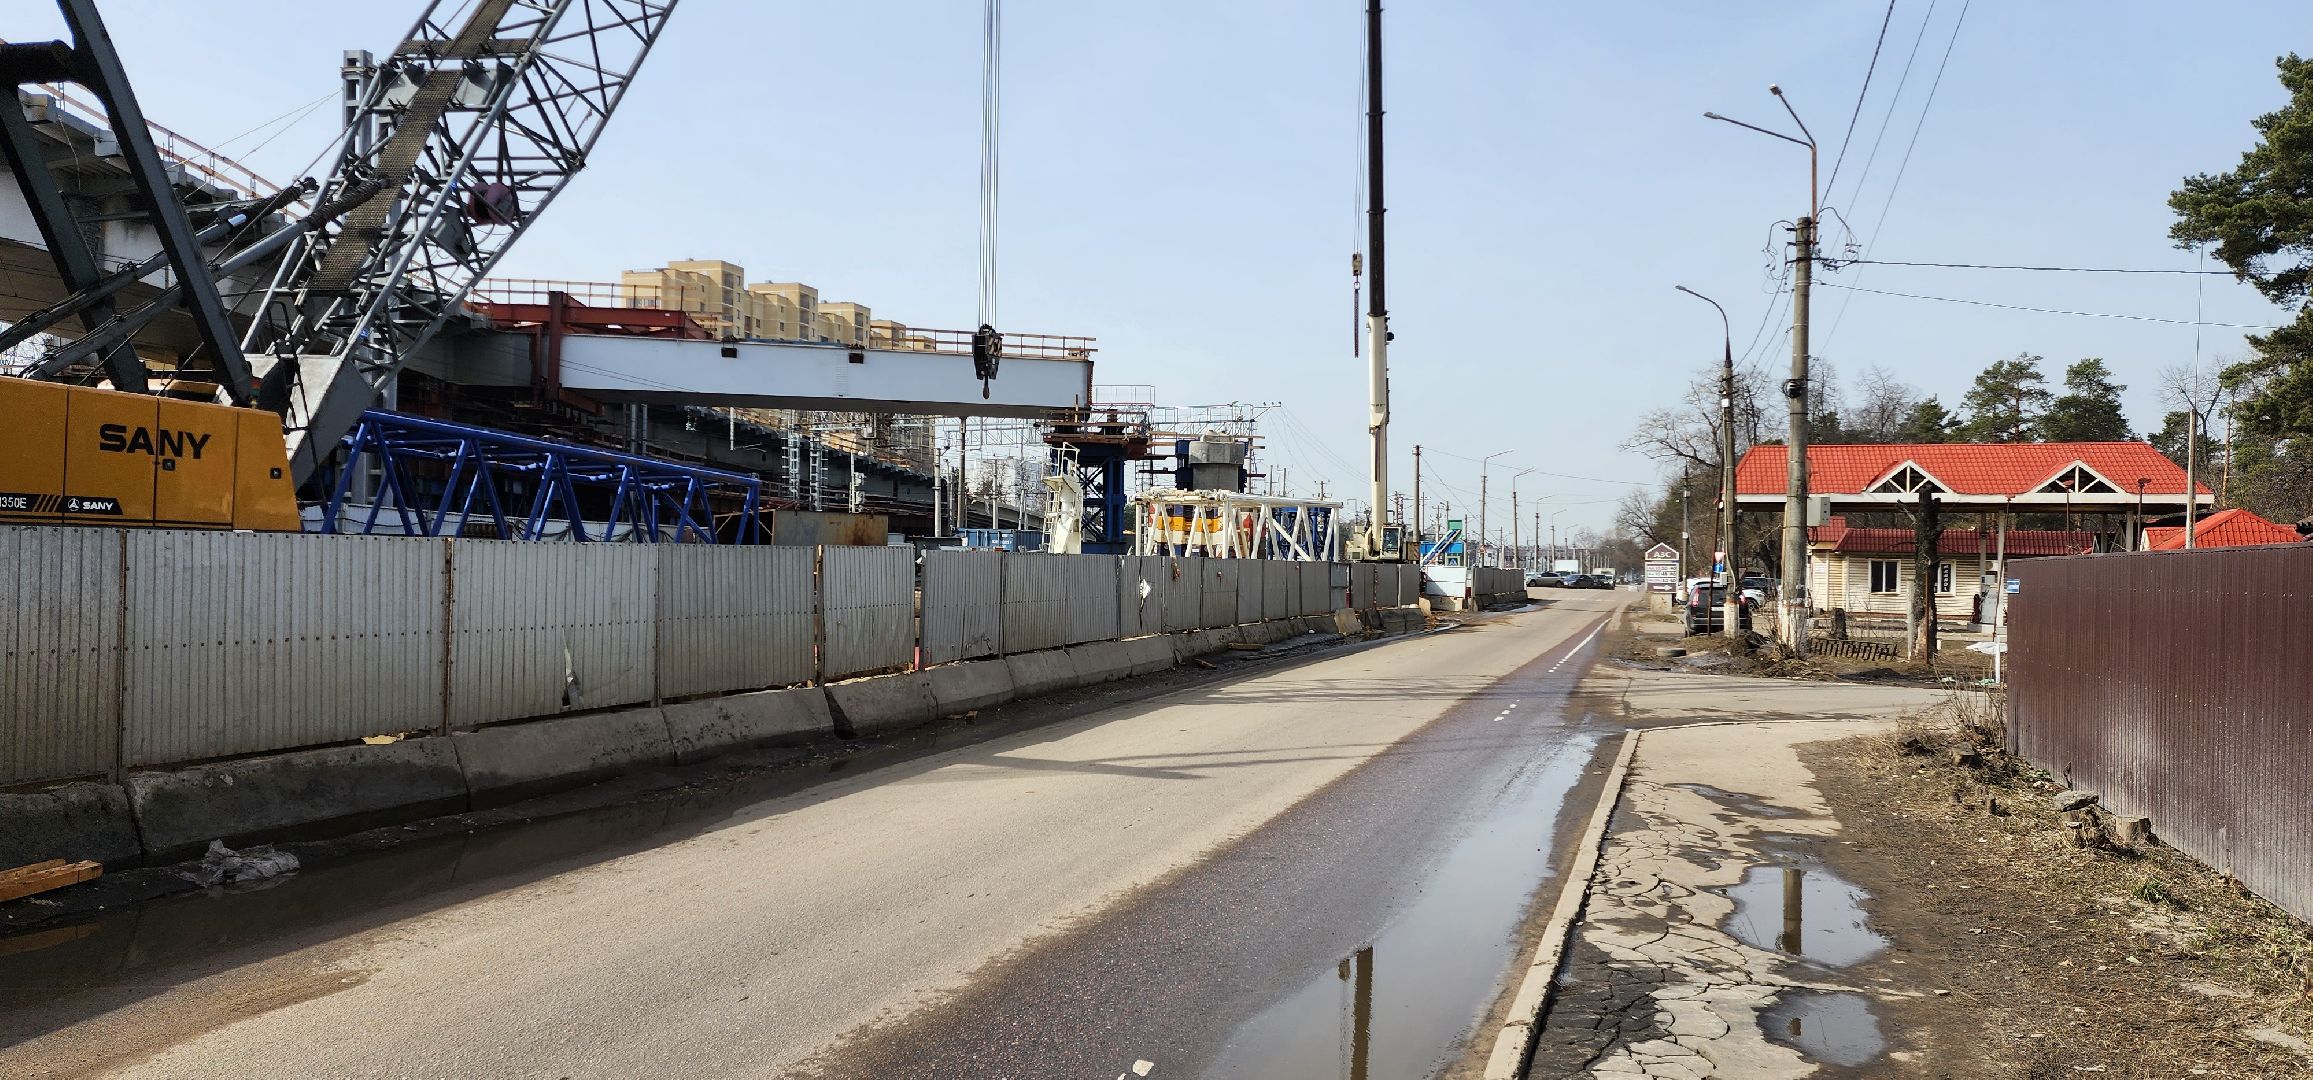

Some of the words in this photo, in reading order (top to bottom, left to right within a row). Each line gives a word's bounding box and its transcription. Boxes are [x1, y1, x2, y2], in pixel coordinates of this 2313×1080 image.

[100, 423, 211, 459] SANY
[0, 496, 27, 509] 350E
[82, 501, 113, 511] SANY
